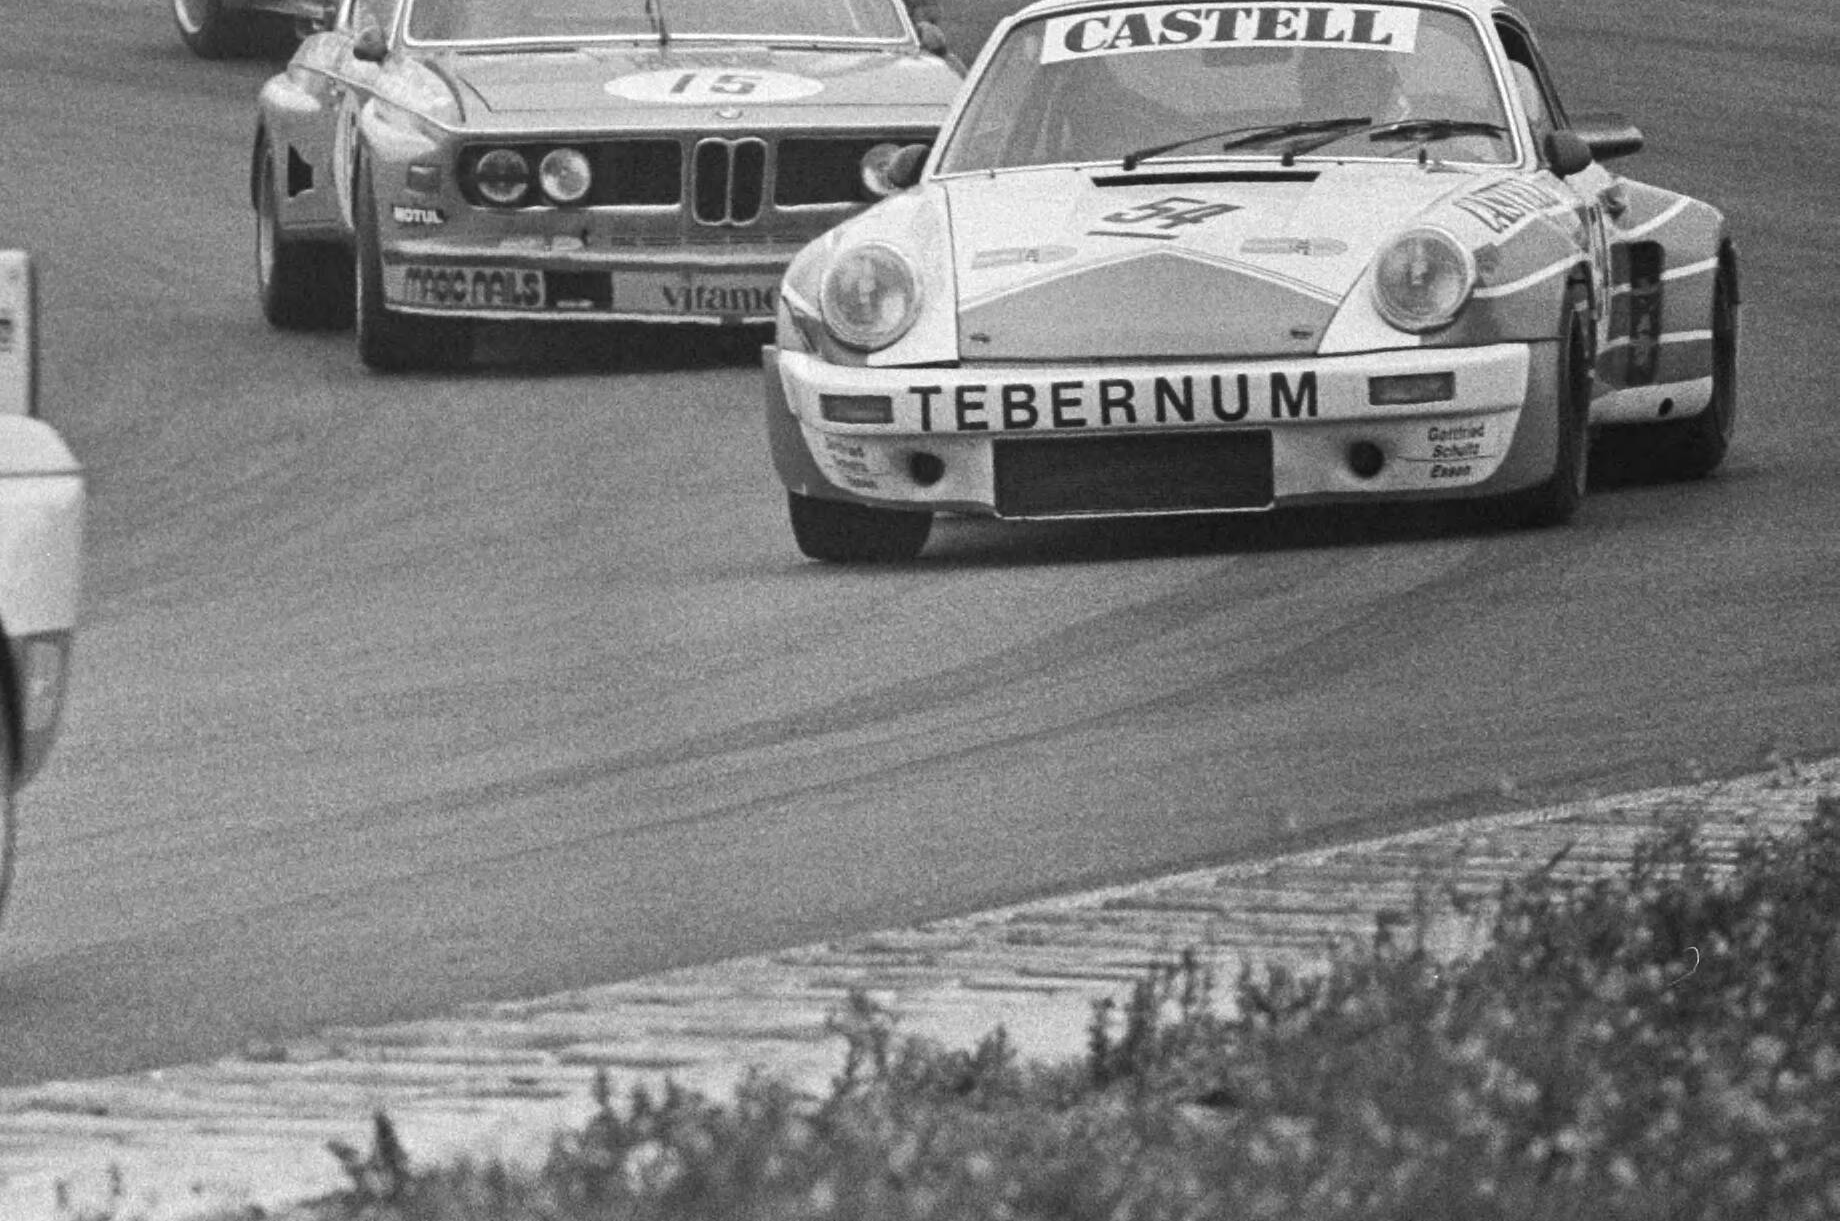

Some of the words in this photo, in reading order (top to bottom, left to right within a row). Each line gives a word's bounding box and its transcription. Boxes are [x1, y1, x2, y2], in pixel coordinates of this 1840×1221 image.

[1063, 6, 1393, 53] CASTELL
[670, 73, 762, 95] 15
[393, 205, 444, 225] MOTUL
[1100, 195, 1245, 230] 54
[908, 370, 1318, 433] TEBERNUM
